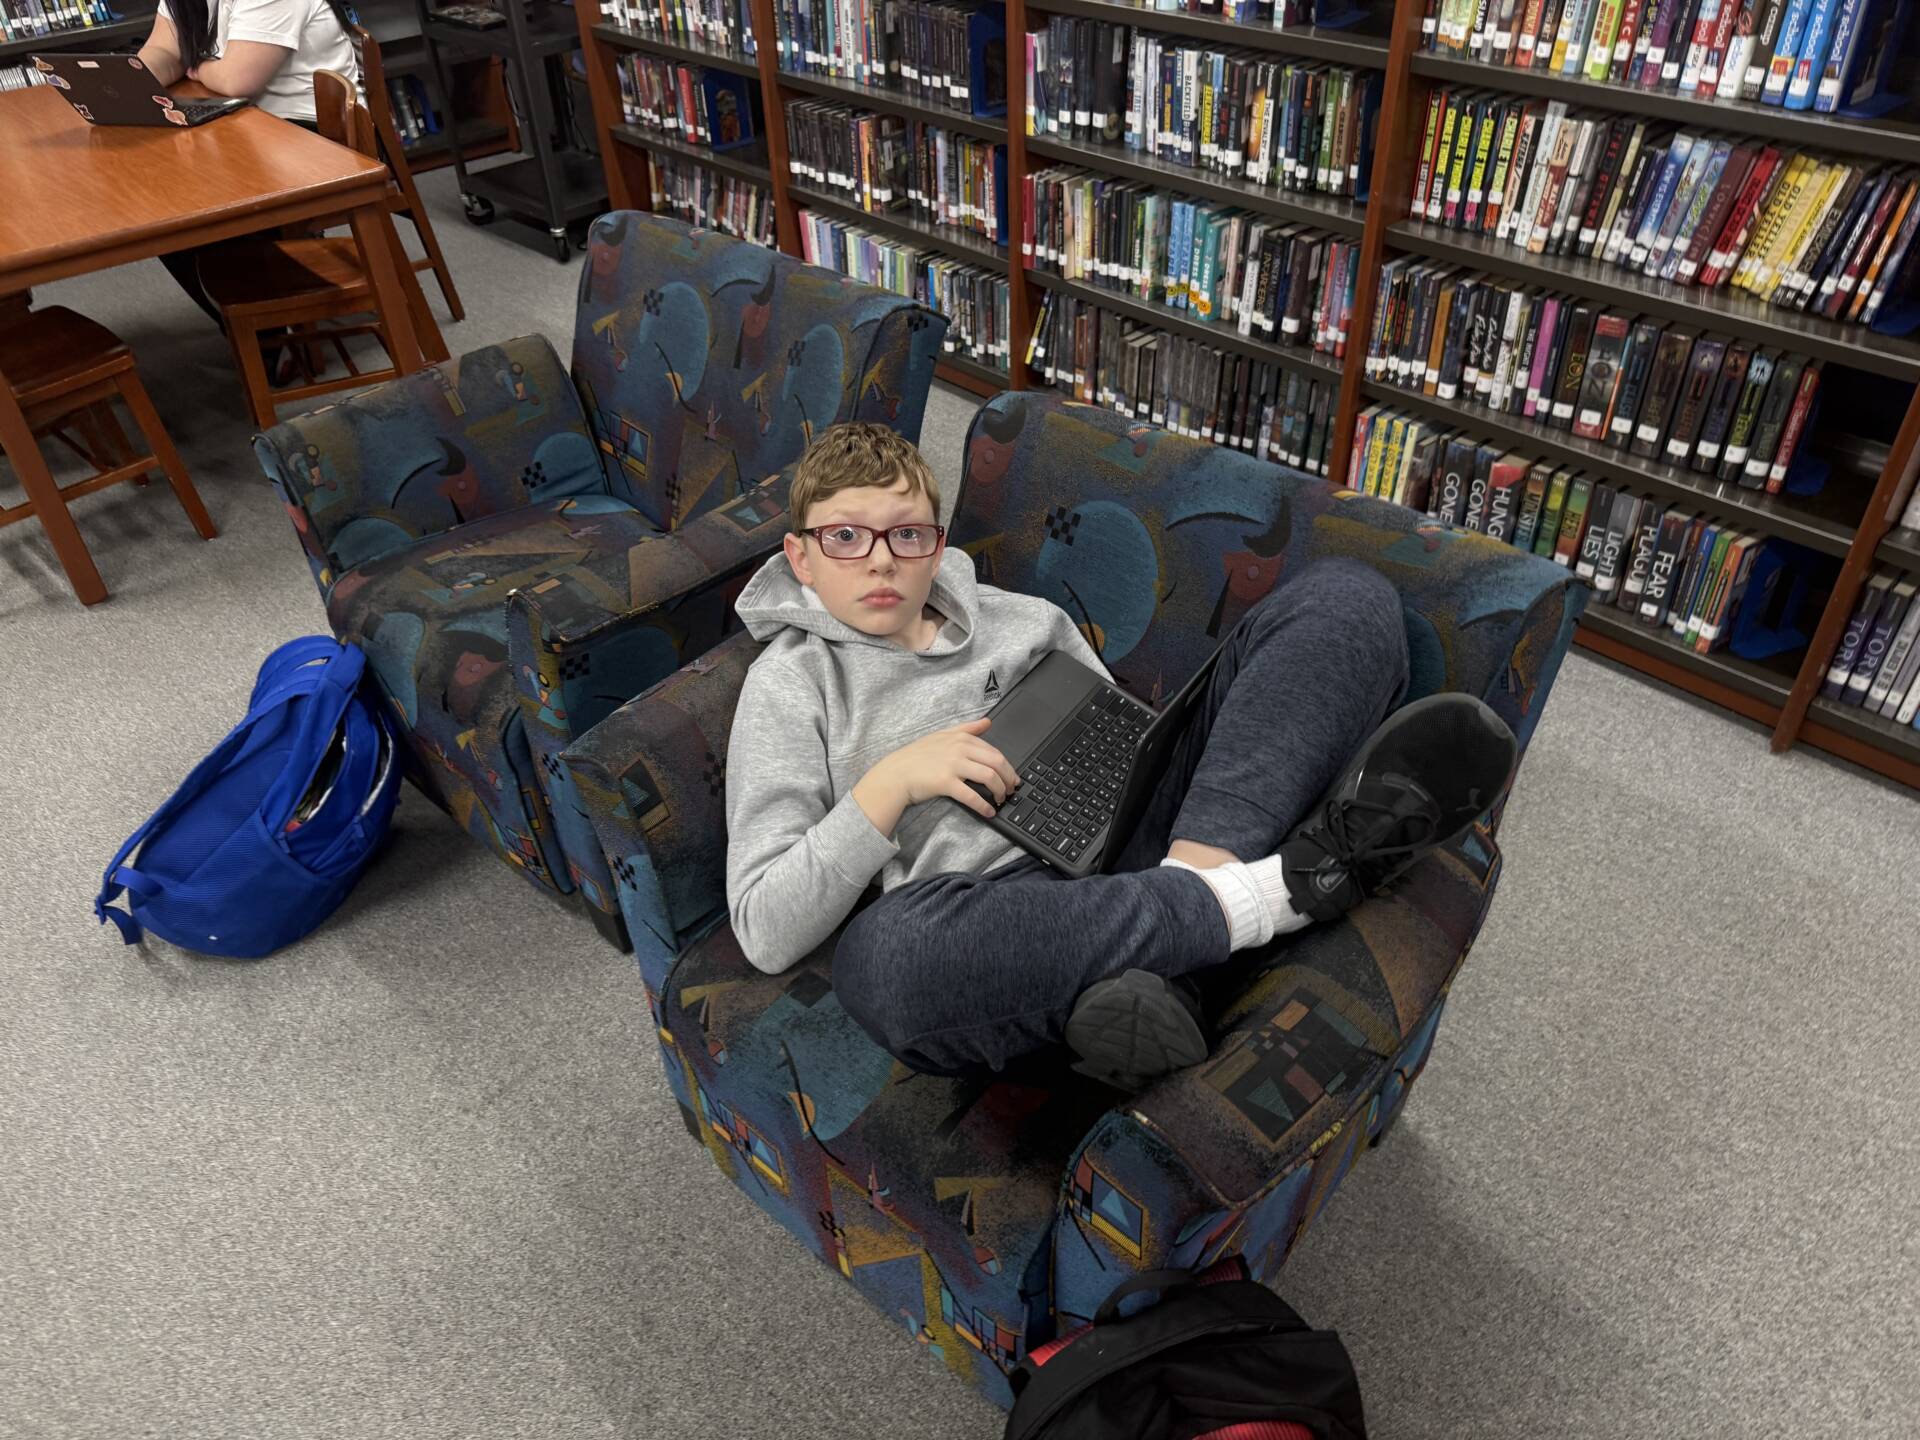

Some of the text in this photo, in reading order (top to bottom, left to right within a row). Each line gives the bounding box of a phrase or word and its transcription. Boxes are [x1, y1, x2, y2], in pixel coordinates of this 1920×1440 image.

[1778, 12, 1805, 58] school
[1801, 14, 1828, 62] school
[1828, 15, 1855, 63] school
[1182, 75, 1192, 119] BACKFIELD
[1448, 158, 1464, 191] THORN
[1469, 162, 1485, 191] THOR
[1490, 160, 1508, 193] THORN
[1781, 184, 1802, 211] OLD
[1743, 180, 1791, 260] OLD YELLER
[1566, 352, 1586, 390] EON
[1617, 383, 1637, 418] CLOSE
[1439, 471, 1460, 523] GONE
[1464, 478, 1486, 530] GONE
[1487, 487, 1510, 541] HUNG
[1583, 525, 1604, 560] LIES
[1600, 530, 1623, 576] LIGHT
[1630, 524, 1658, 584] PLAGU
[1646, 550, 1674, 600] FEAR
